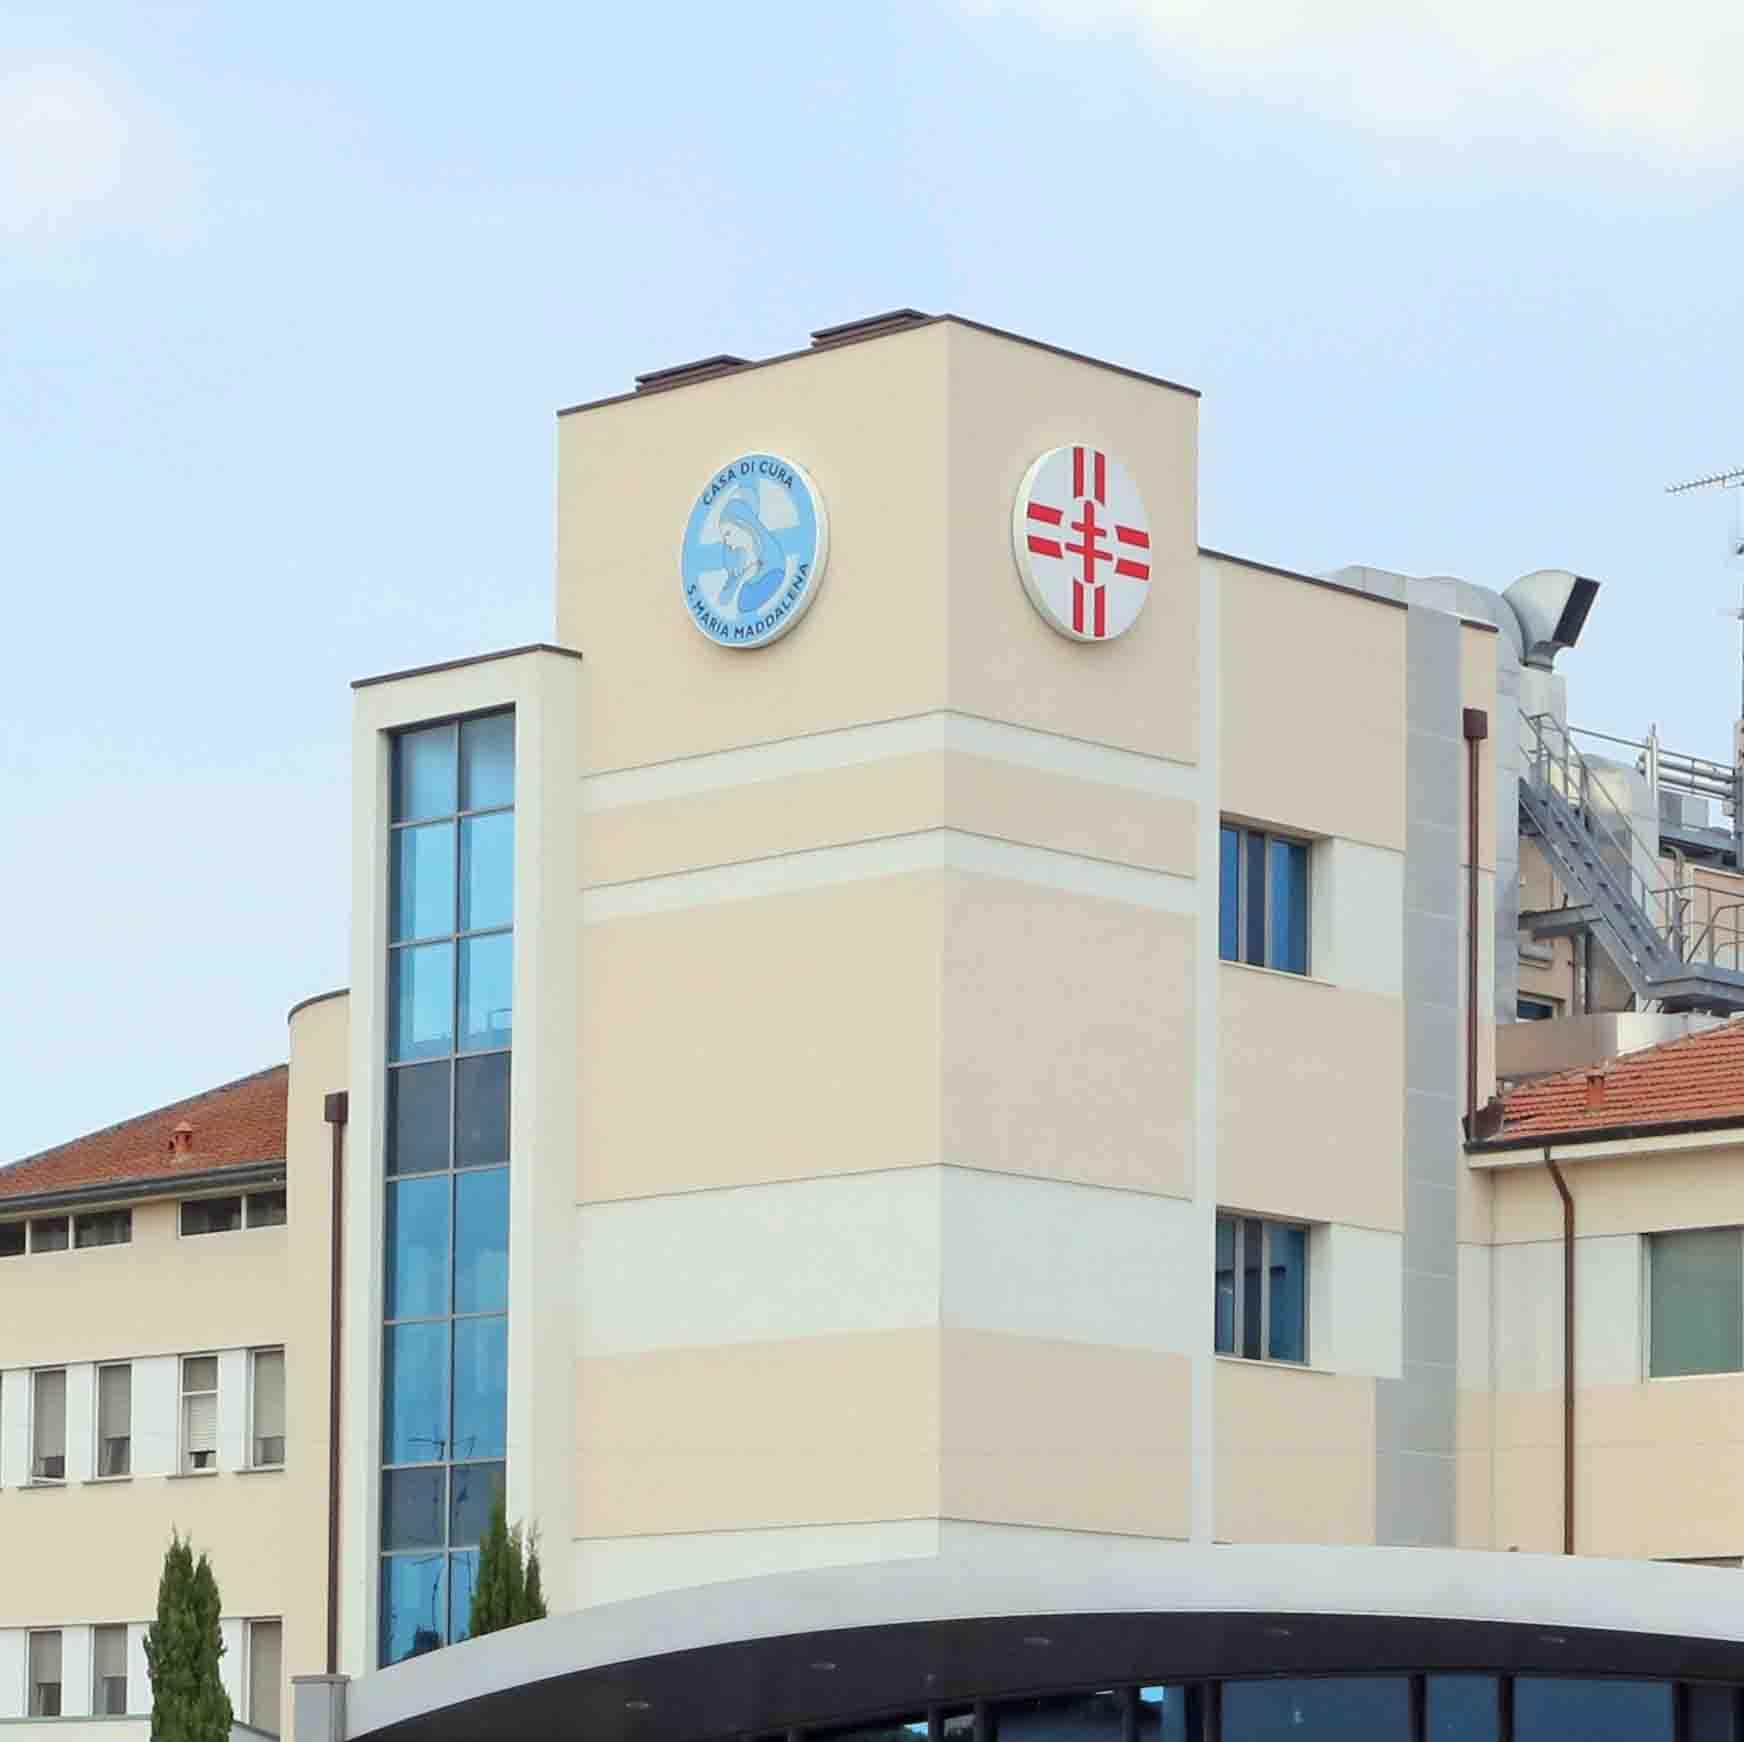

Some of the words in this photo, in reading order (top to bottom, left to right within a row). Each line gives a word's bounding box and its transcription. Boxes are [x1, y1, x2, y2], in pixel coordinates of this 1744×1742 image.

[704, 468, 736, 505] CASA
[741, 462, 754, 475] DI
[759, 460, 793, 489] CURA
[692, 599, 729, 639] MARIA
[735, 562, 809, 640] MADDALENA
